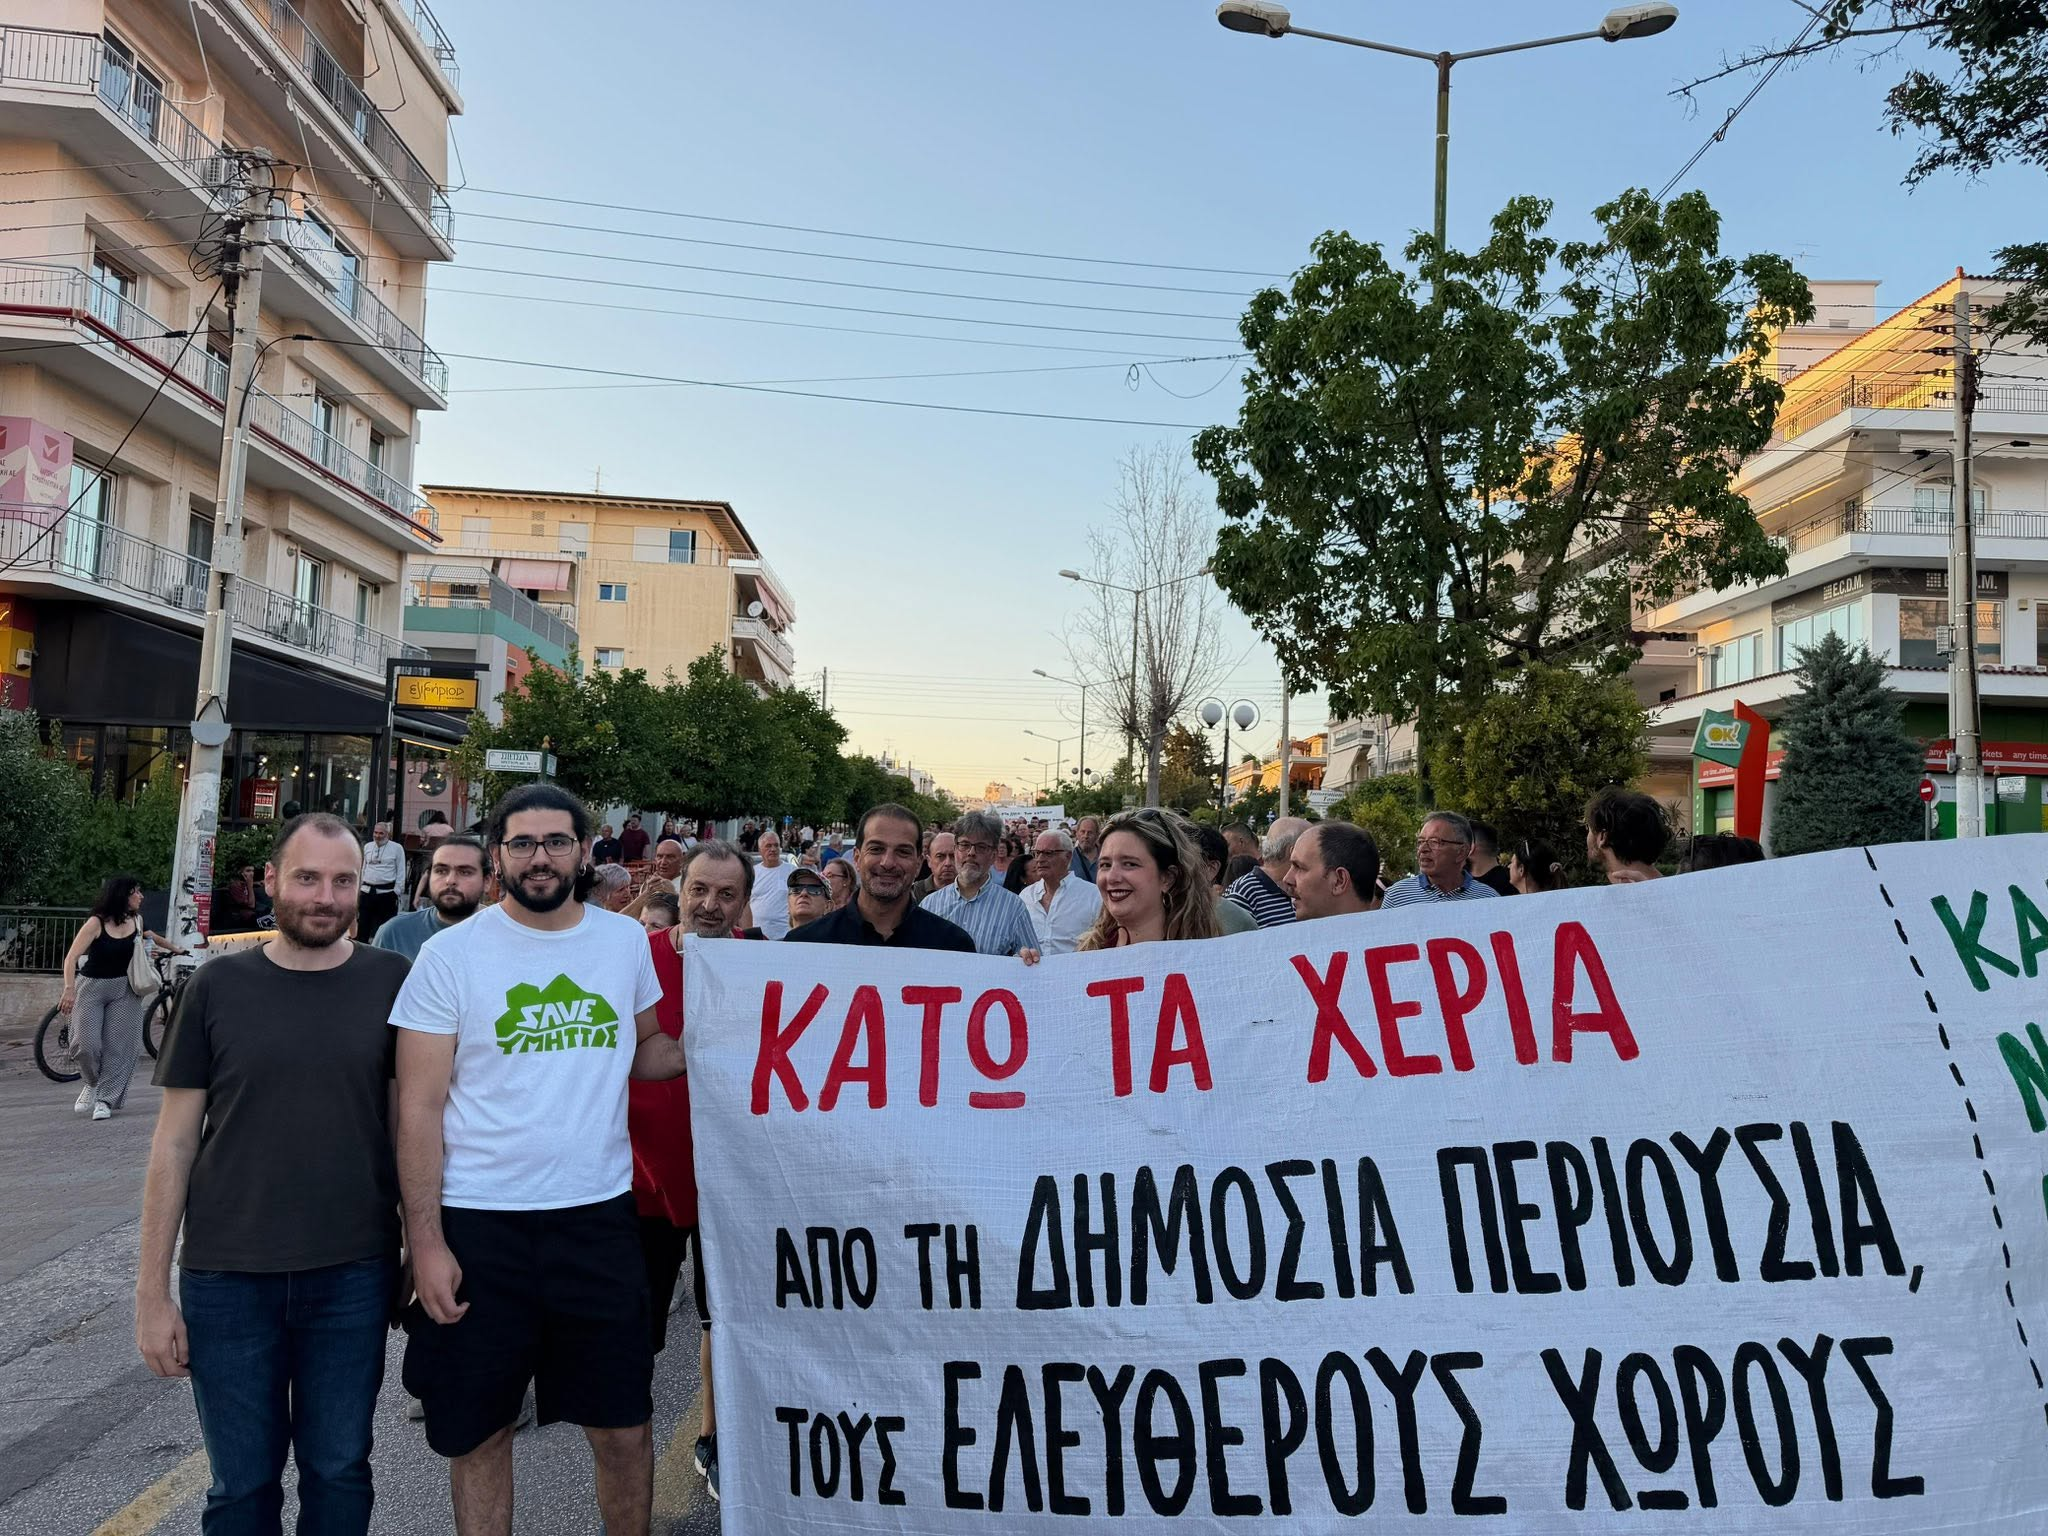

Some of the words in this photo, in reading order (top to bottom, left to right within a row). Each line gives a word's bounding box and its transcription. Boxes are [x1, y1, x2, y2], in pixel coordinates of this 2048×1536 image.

[1832, 574, 1864, 598] E.C.D.M.
[1928, 748, 1943, 757] any
[2013, 751, 2027, 760] any
[516, 998, 597, 1030] SAVE
[750, 979, 1029, 1116] ΚΑΤΩ
[1086, 972, 1212, 1098] ΤΑ
[1289, 919, 1640, 1084] ΧΕΡΙΑ
[775, 1225, 878, 1310] ΑΠΟ
[904, 1222, 982, 1310] ΤΗ
[1015, 1155, 1415, 1311] ΔΗΜΟΣΙΑ
[1436, 1119, 1925, 1295] ΠΕΡΙΟΥΣΙΑ,
[775, 1404, 907, 1507] ΤΟΥΣ
[942, 1345, 1508, 1518] ΕΛΕΥΘΕΡΟΥΣ
[1540, 1333, 1926, 1512] ΧΩΡΟΥΣ
